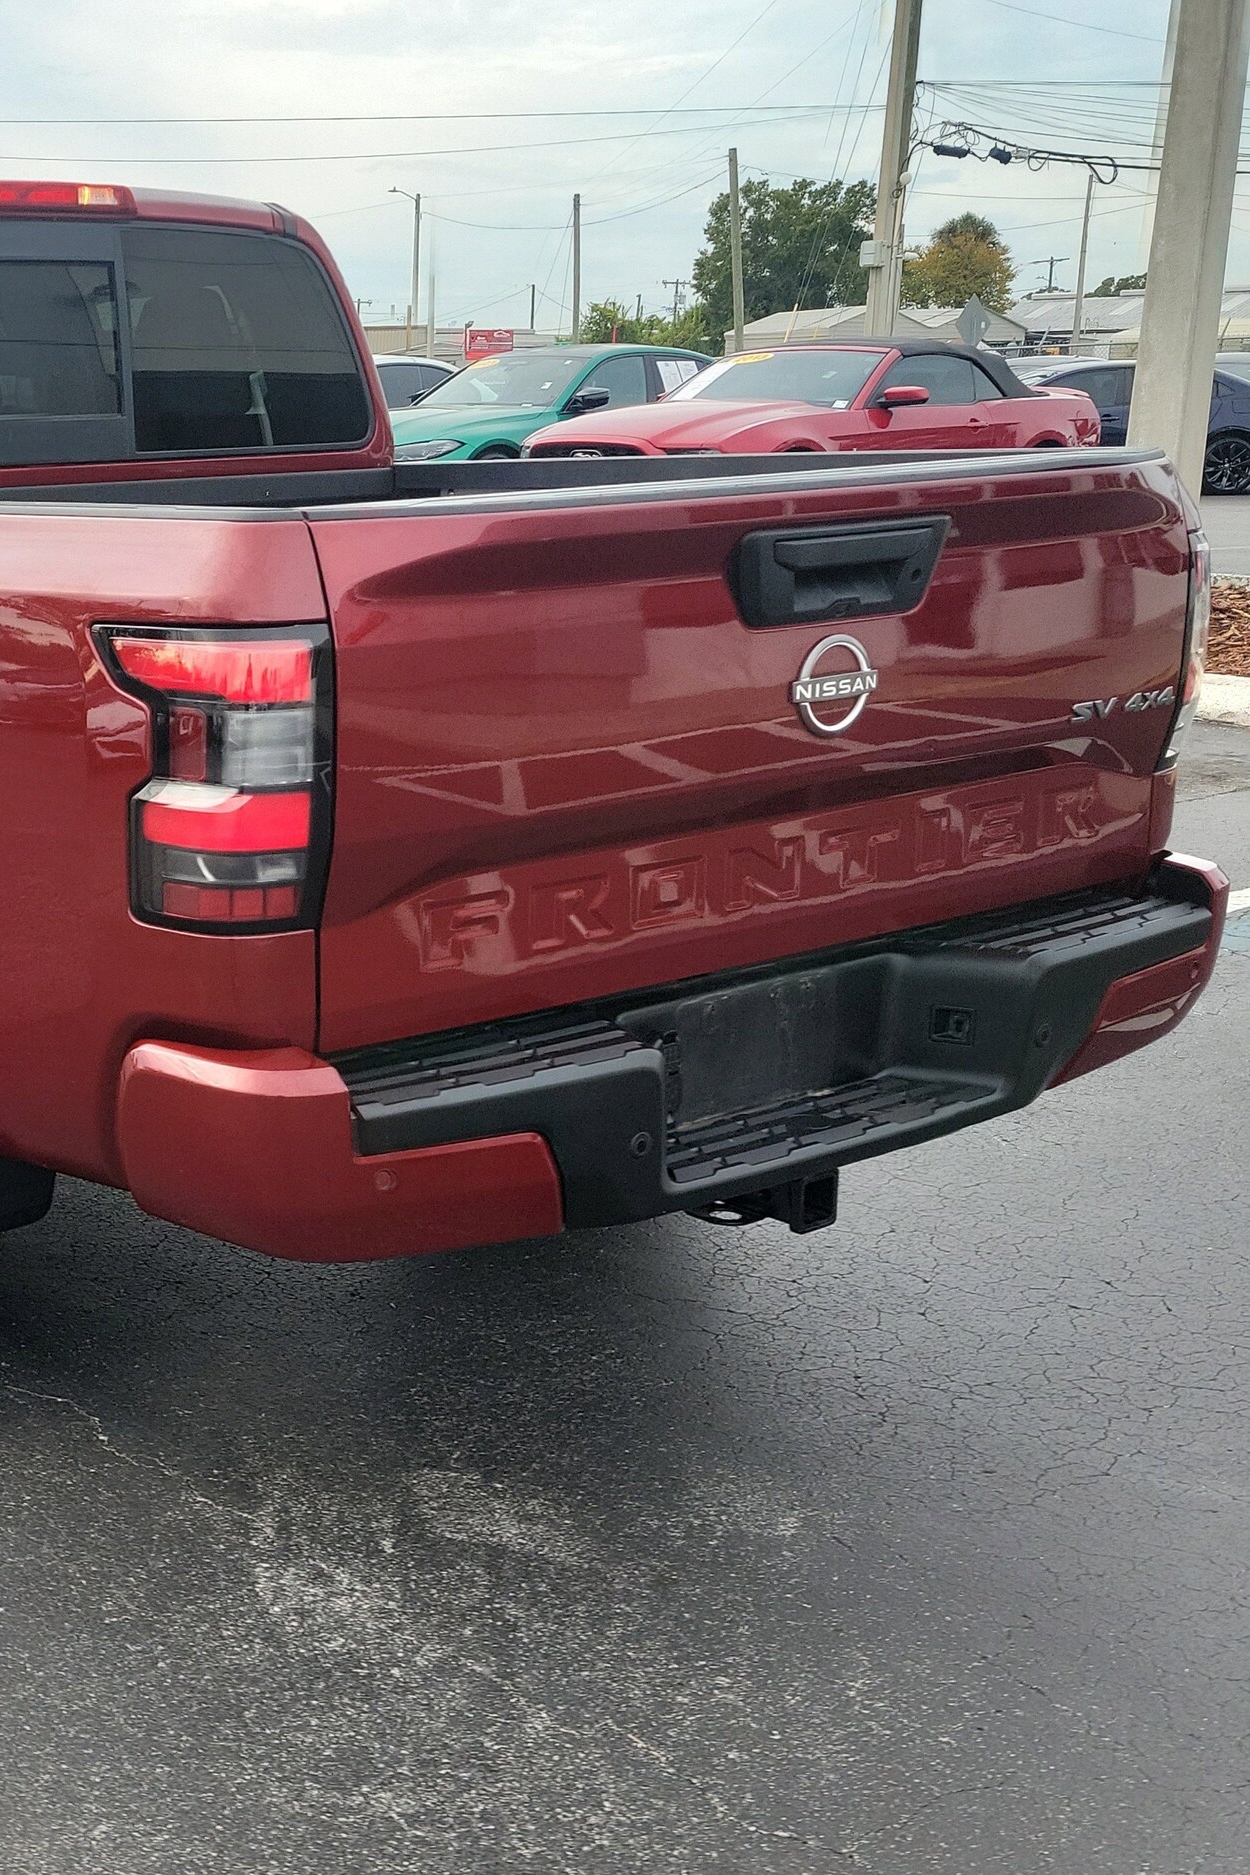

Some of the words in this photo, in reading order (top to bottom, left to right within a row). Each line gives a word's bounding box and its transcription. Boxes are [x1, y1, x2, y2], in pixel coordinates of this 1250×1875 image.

[795, 673, 877, 700] NISSAN
[1070, 696, 1118, 722] SV
[418, 787, 1101, 973] FRONTIER
